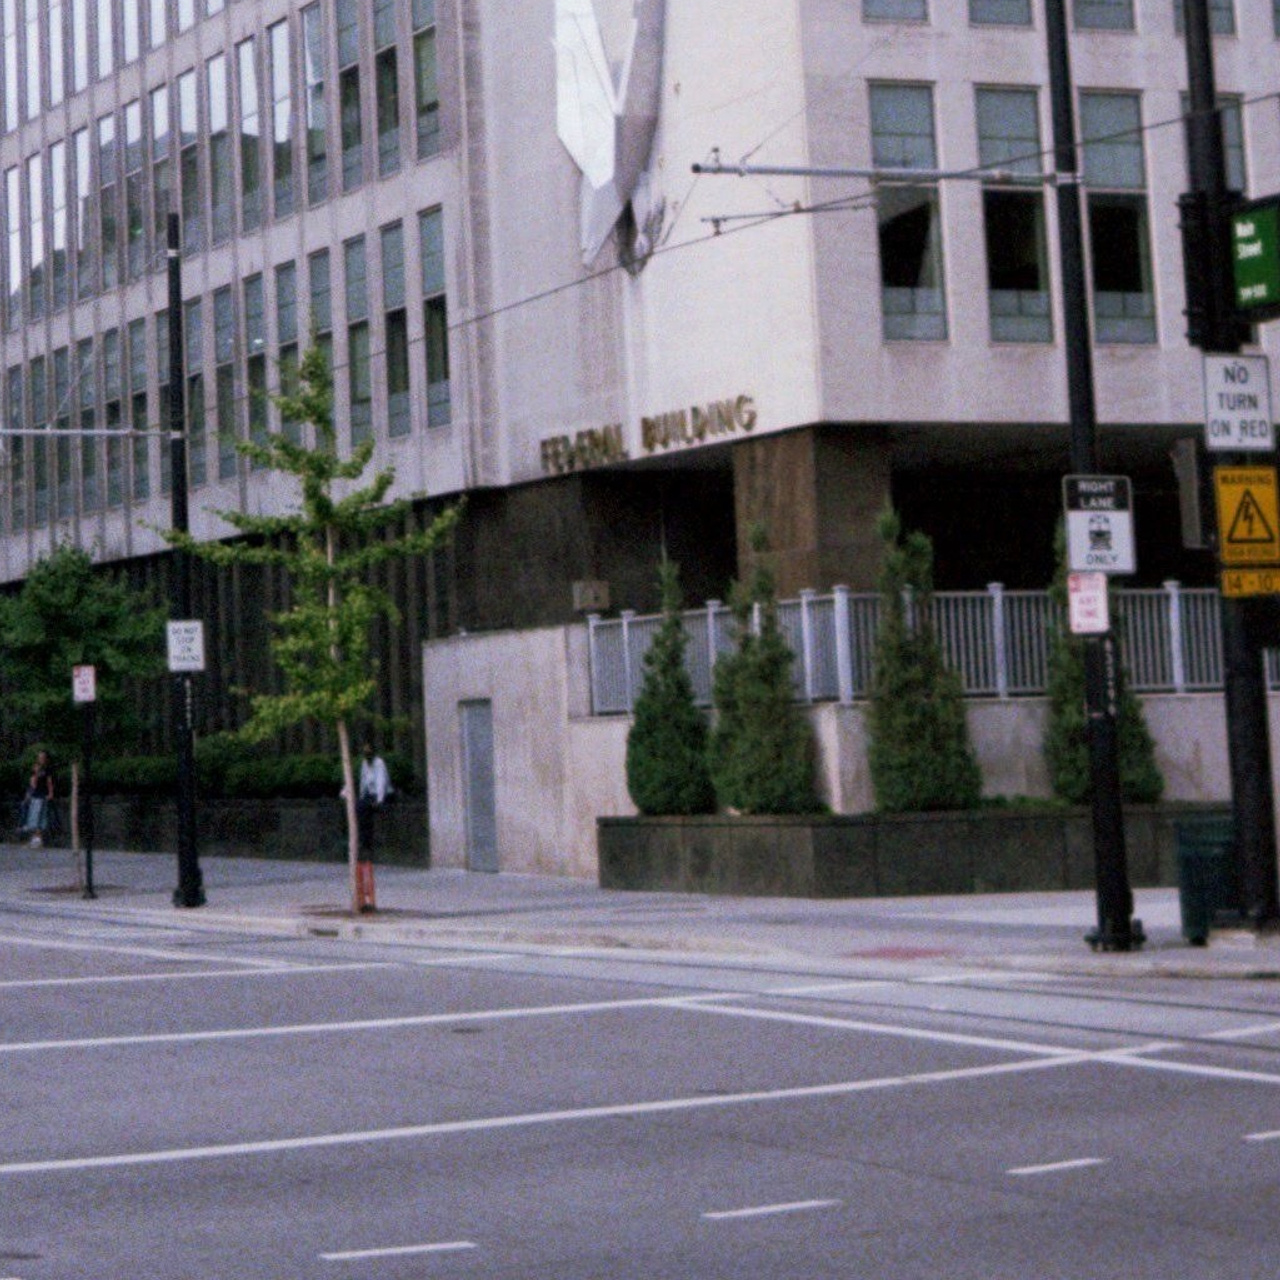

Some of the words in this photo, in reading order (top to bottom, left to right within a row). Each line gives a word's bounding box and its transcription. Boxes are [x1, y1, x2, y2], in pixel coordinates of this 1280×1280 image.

[1224, 365, 1249, 384] NO
[1218, 392, 1259, 410] TURN
[640, 393, 757, 453] BUILDING
[1211, 419, 1231, 437] ON
[1239, 419, 1268, 438] RED
[1077, 479, 1115, 493] RIGHT
[1080, 496, 1114, 509] LANE
[1086, 553, 1119, 566] ONLY
[172, 627, 182, 635] DO
[184, 627, 198, 635] NOT
